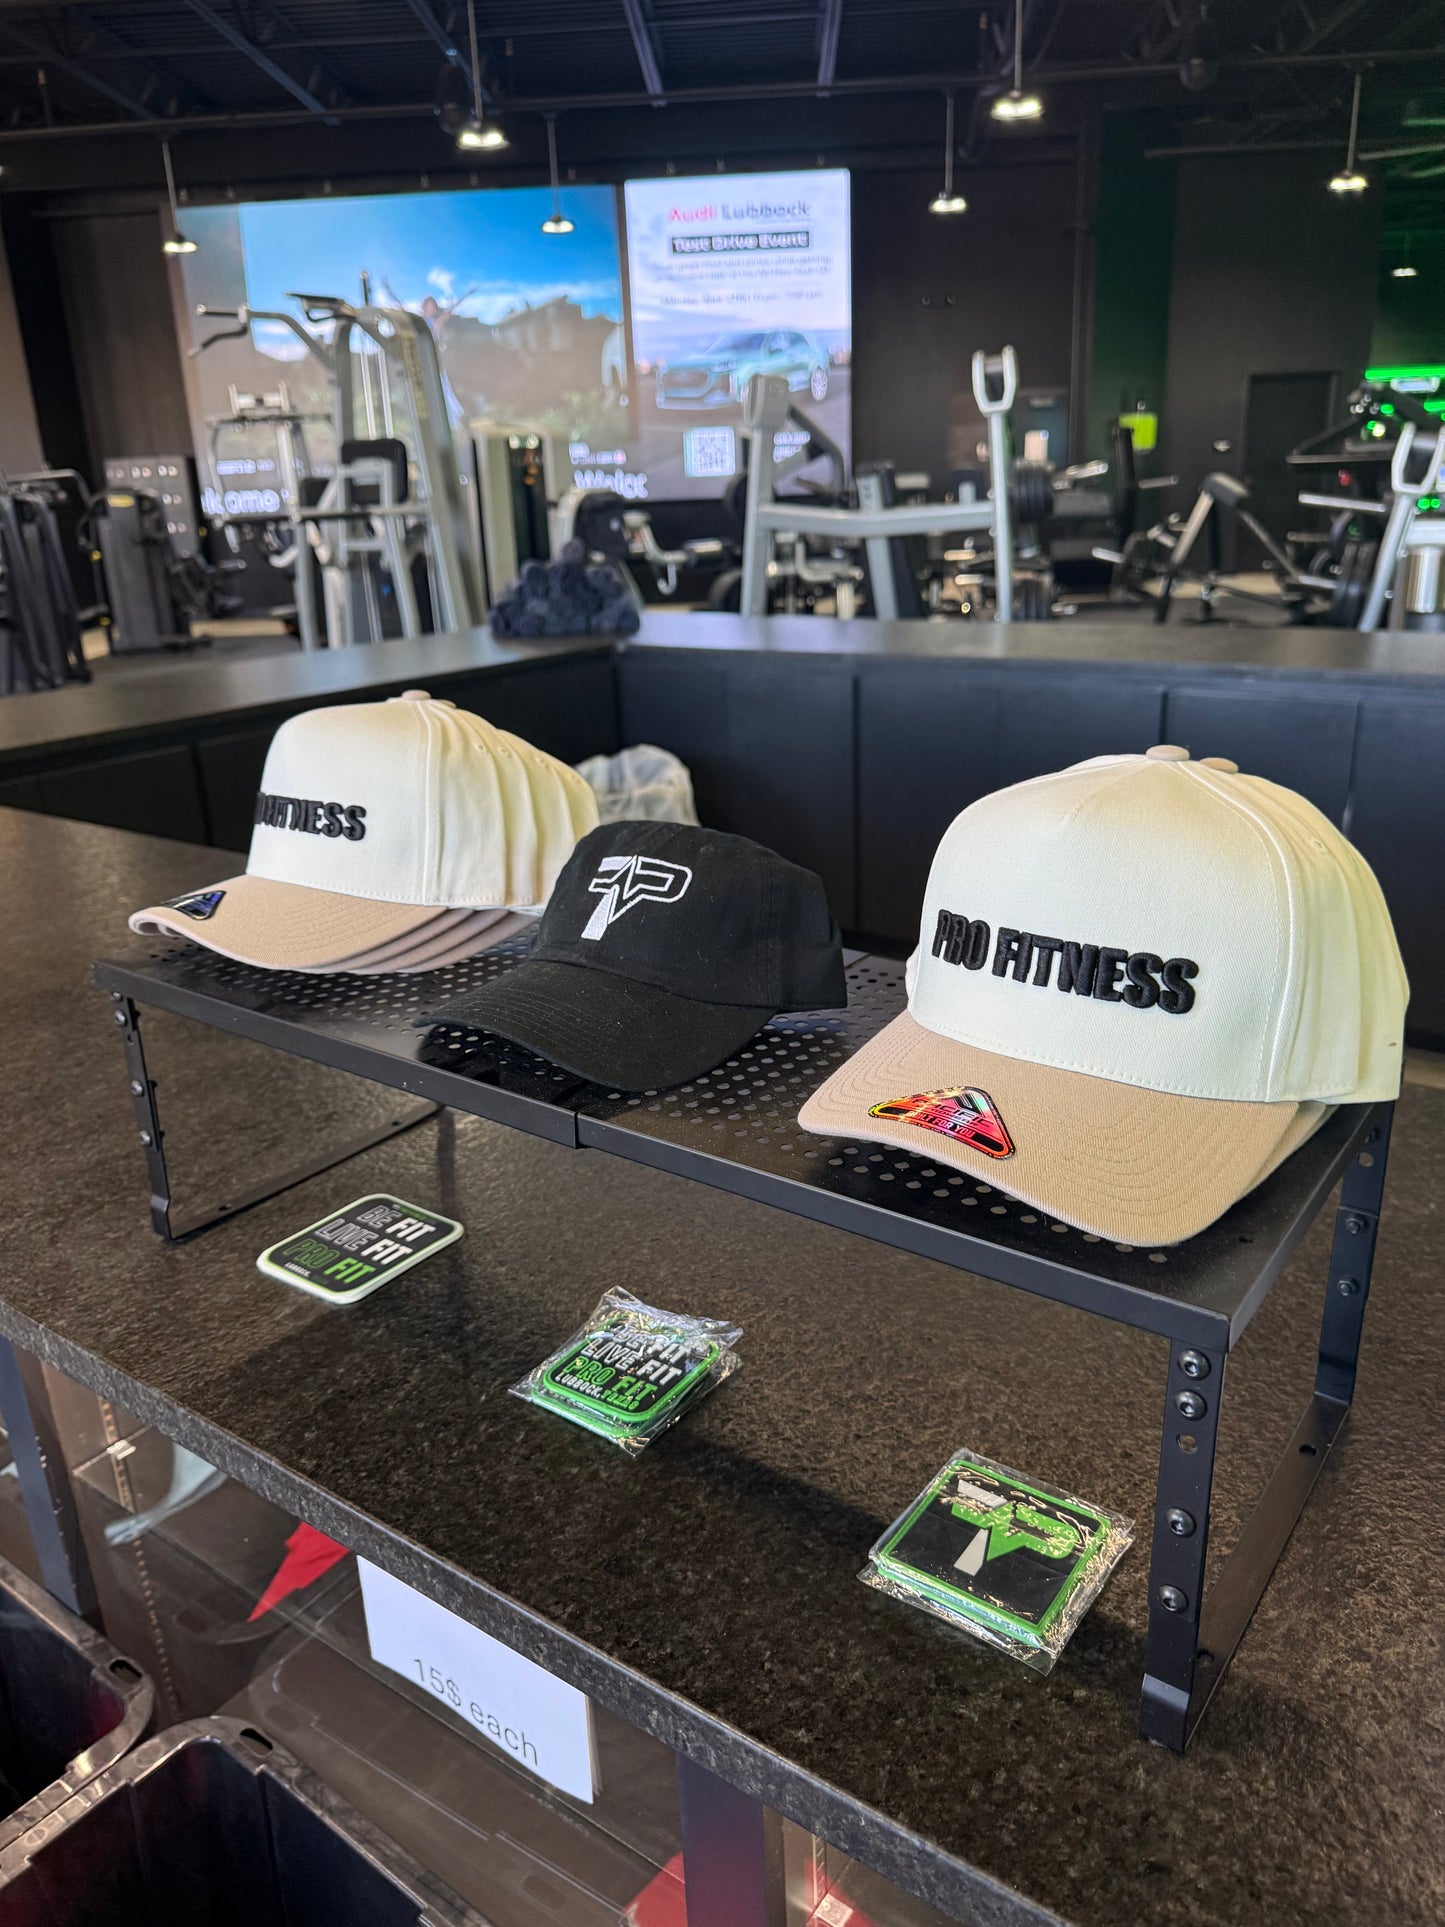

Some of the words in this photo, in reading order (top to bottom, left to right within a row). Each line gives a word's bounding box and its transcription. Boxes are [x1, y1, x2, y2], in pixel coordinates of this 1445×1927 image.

[668, 204, 716, 222] Audi
[932, 909, 990, 970] PRO
[992, 927, 1199, 1014] FITNESS
[905, 1110, 933, 1122] BUILT
[932, 1117, 953, 1129] FOR
[954, 1125, 975, 1138] YOU
[314, 1218, 379, 1253] LIVE
[360, 1238, 413, 1265] FIT
[356, 1204, 403, 1230] BE
[385, 1218, 436, 1242] FIT
[282, 1238, 341, 1268] PRO
[324, 1257, 376, 1284] FIT
[563, 1356, 616, 1385] PRO
[612, 1375, 658, 1402] FIT
[581, 1338, 641, 1371] LIVE
[636, 1359, 682, 1385] FIT
[555, 1372, 603, 1399] LUBBOCK,
[414, 1659, 461, 1707] 15$
[470, 1701, 538, 1766] each
